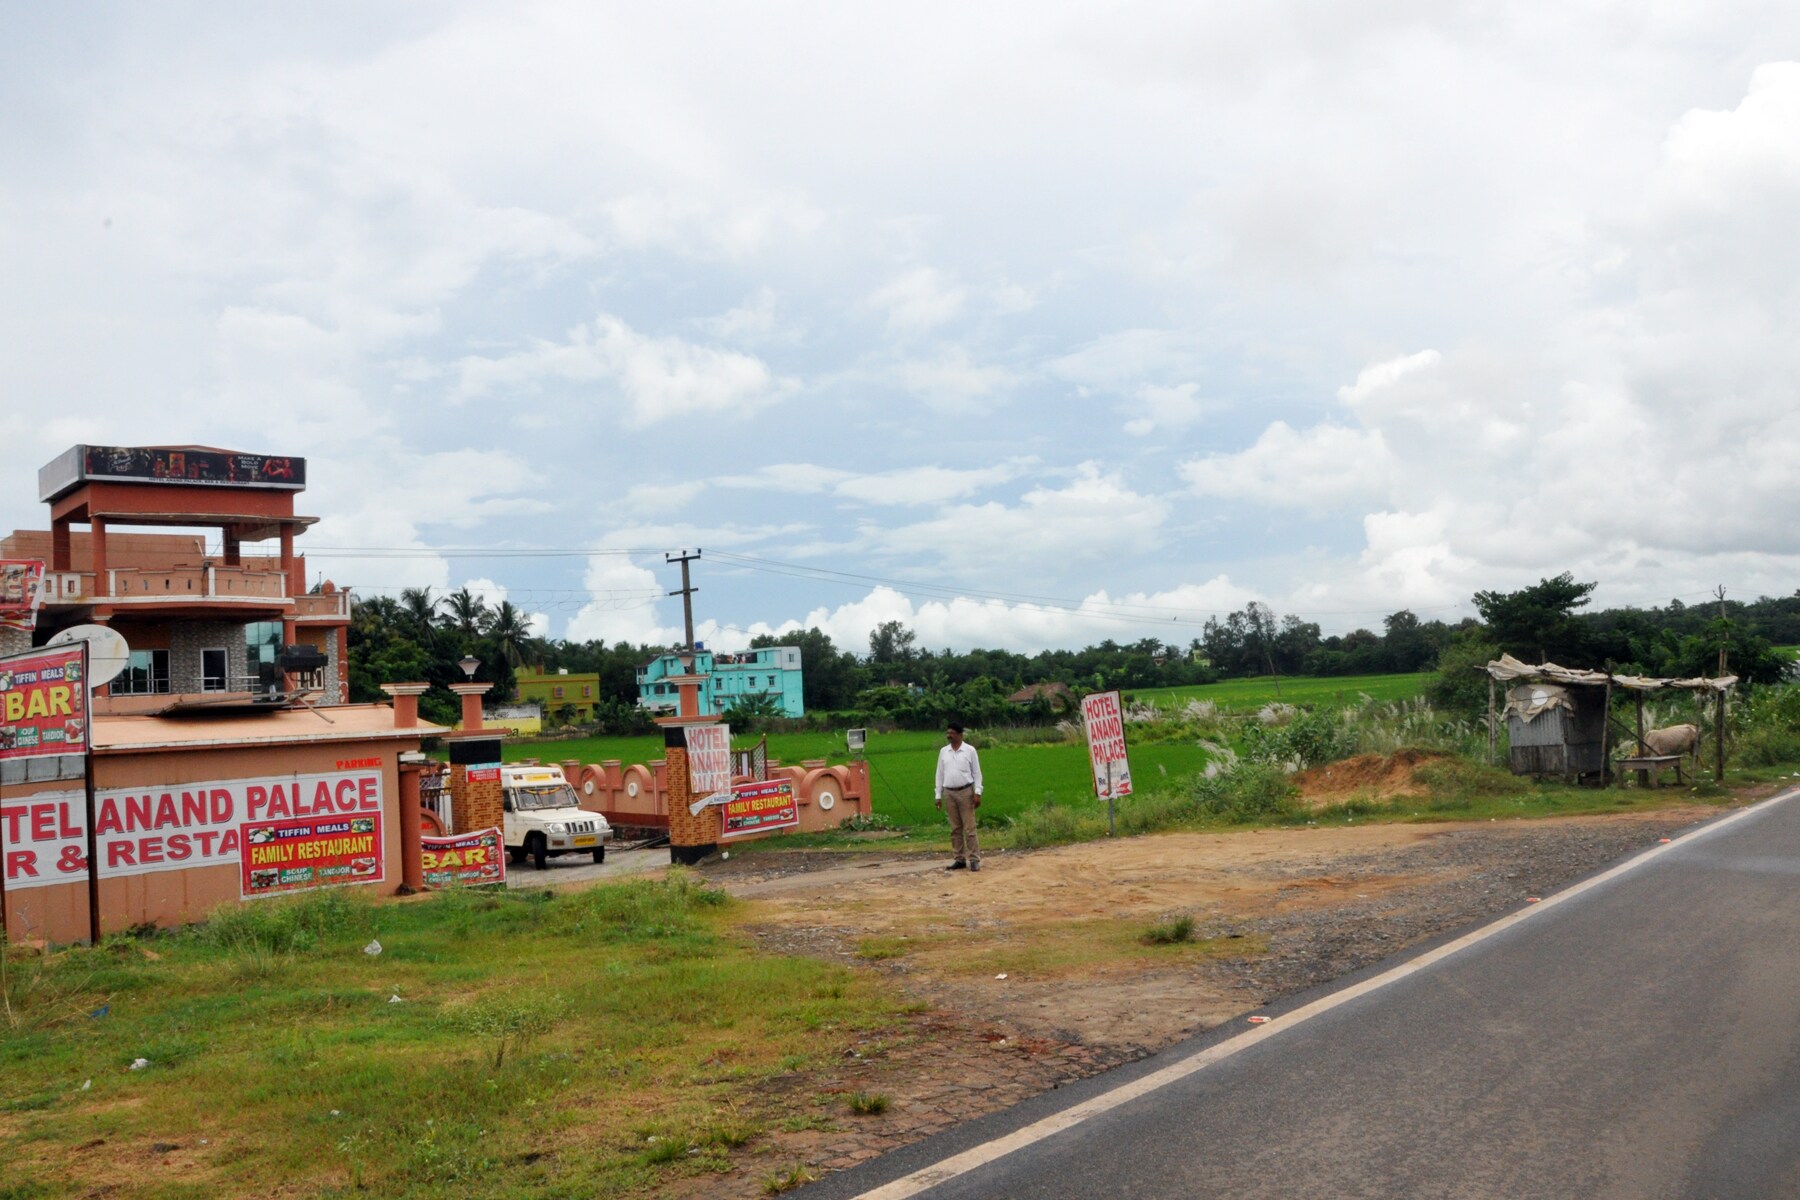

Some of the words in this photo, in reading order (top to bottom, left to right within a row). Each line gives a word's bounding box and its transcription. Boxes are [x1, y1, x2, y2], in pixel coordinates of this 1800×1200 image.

[15, 671, 37, 684] TIFFIN
[41, 667, 64, 680] MEALS
[5, 685, 73, 722] BAR
[1085, 696, 1117, 721] HOTEL
[688, 727, 728, 751] HOTEL
[1090, 716, 1121, 743] ANAND
[336, 757, 382, 769] PARKING
[690, 751, 729, 775] ANAND
[1093, 738, 1126, 765] PALACE
[691, 772, 730, 796] PALACE
[741, 790, 758, 798] TIFFIN
[0, 801, 83, 844] TEL
[96, 788, 235, 836] ANAND
[246, 777, 379, 821] PALACE
[728, 800, 750, 815] FAMILY
[751, 795, 791, 811] RESTAURANT
[277, 827, 311, 838] TIFFIN
[316, 823, 349, 834] MEALS
[7, 850, 39, 879] R
[56, 845, 89, 873] &
[107, 828, 239, 868] RESTA
[251, 844, 294, 865] FAMILY
[298, 836, 373, 860] RESTAURANT
[455, 839, 480, 848] MEALS
[285, 867, 308, 875] SOUP
[421, 848, 487, 870] BAR
[281, 873, 312, 883] CHINESE
